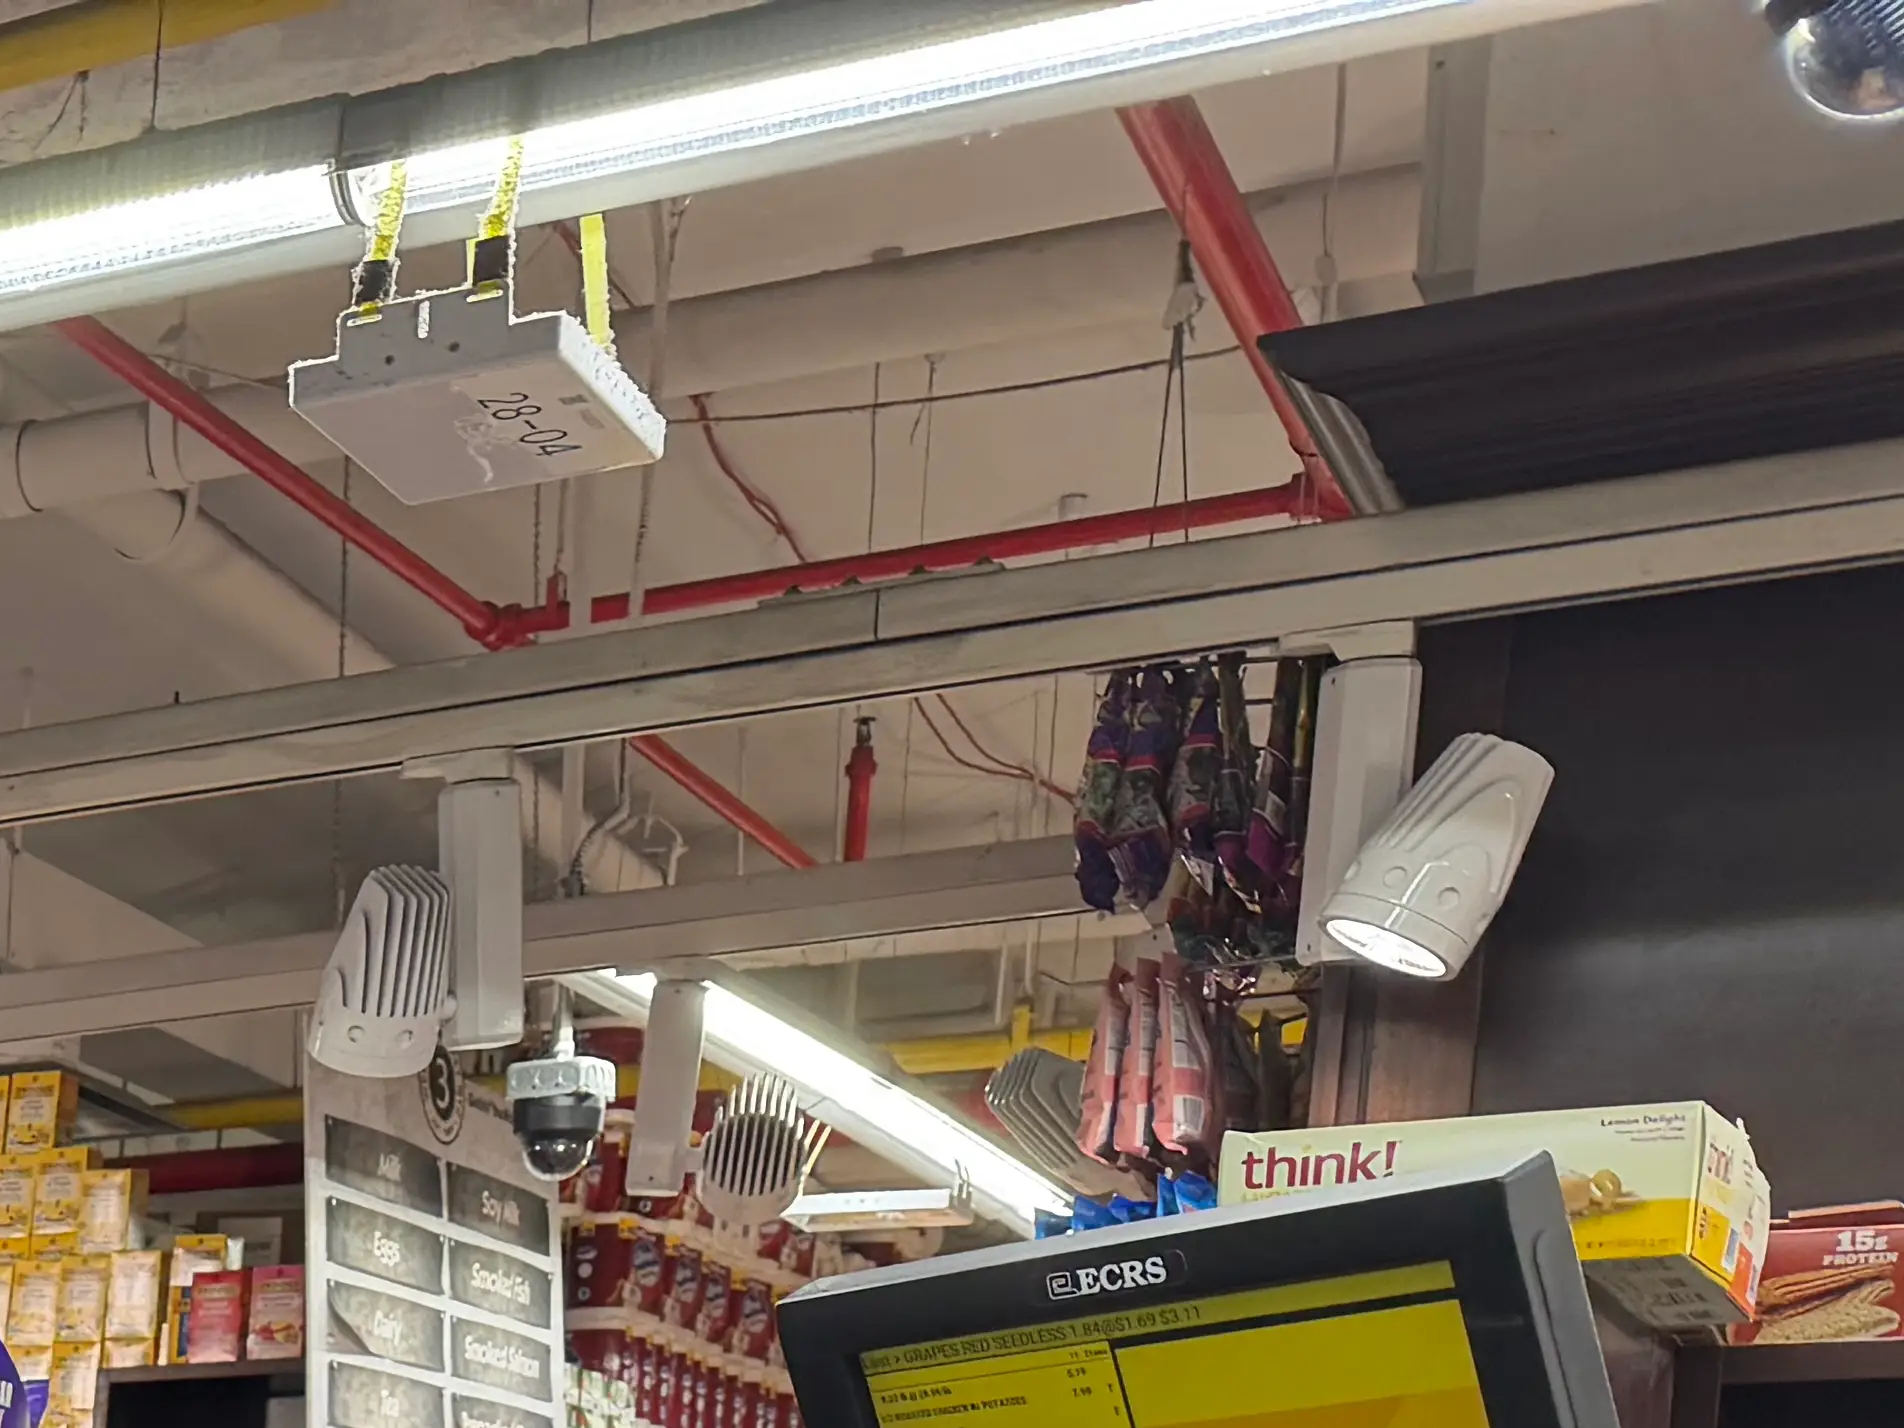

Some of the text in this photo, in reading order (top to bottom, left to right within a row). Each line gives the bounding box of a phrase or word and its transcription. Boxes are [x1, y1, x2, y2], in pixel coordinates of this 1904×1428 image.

[1241, 1139, 1400, 1190] think!
[372, 1231, 401, 1267] Eggs
[1822, 1251, 1898, 1265] PROTEIN
[511, 1276, 532, 1306] Fish
[1075, 1255, 1169, 1297] ECRS
[372, 1308, 403, 1347] Dairy
[903, 1345, 959, 1364] GRAPES
[961, 1339, 990, 1357] RED
[991, 1326, 1068, 1351] SEEDLESS
